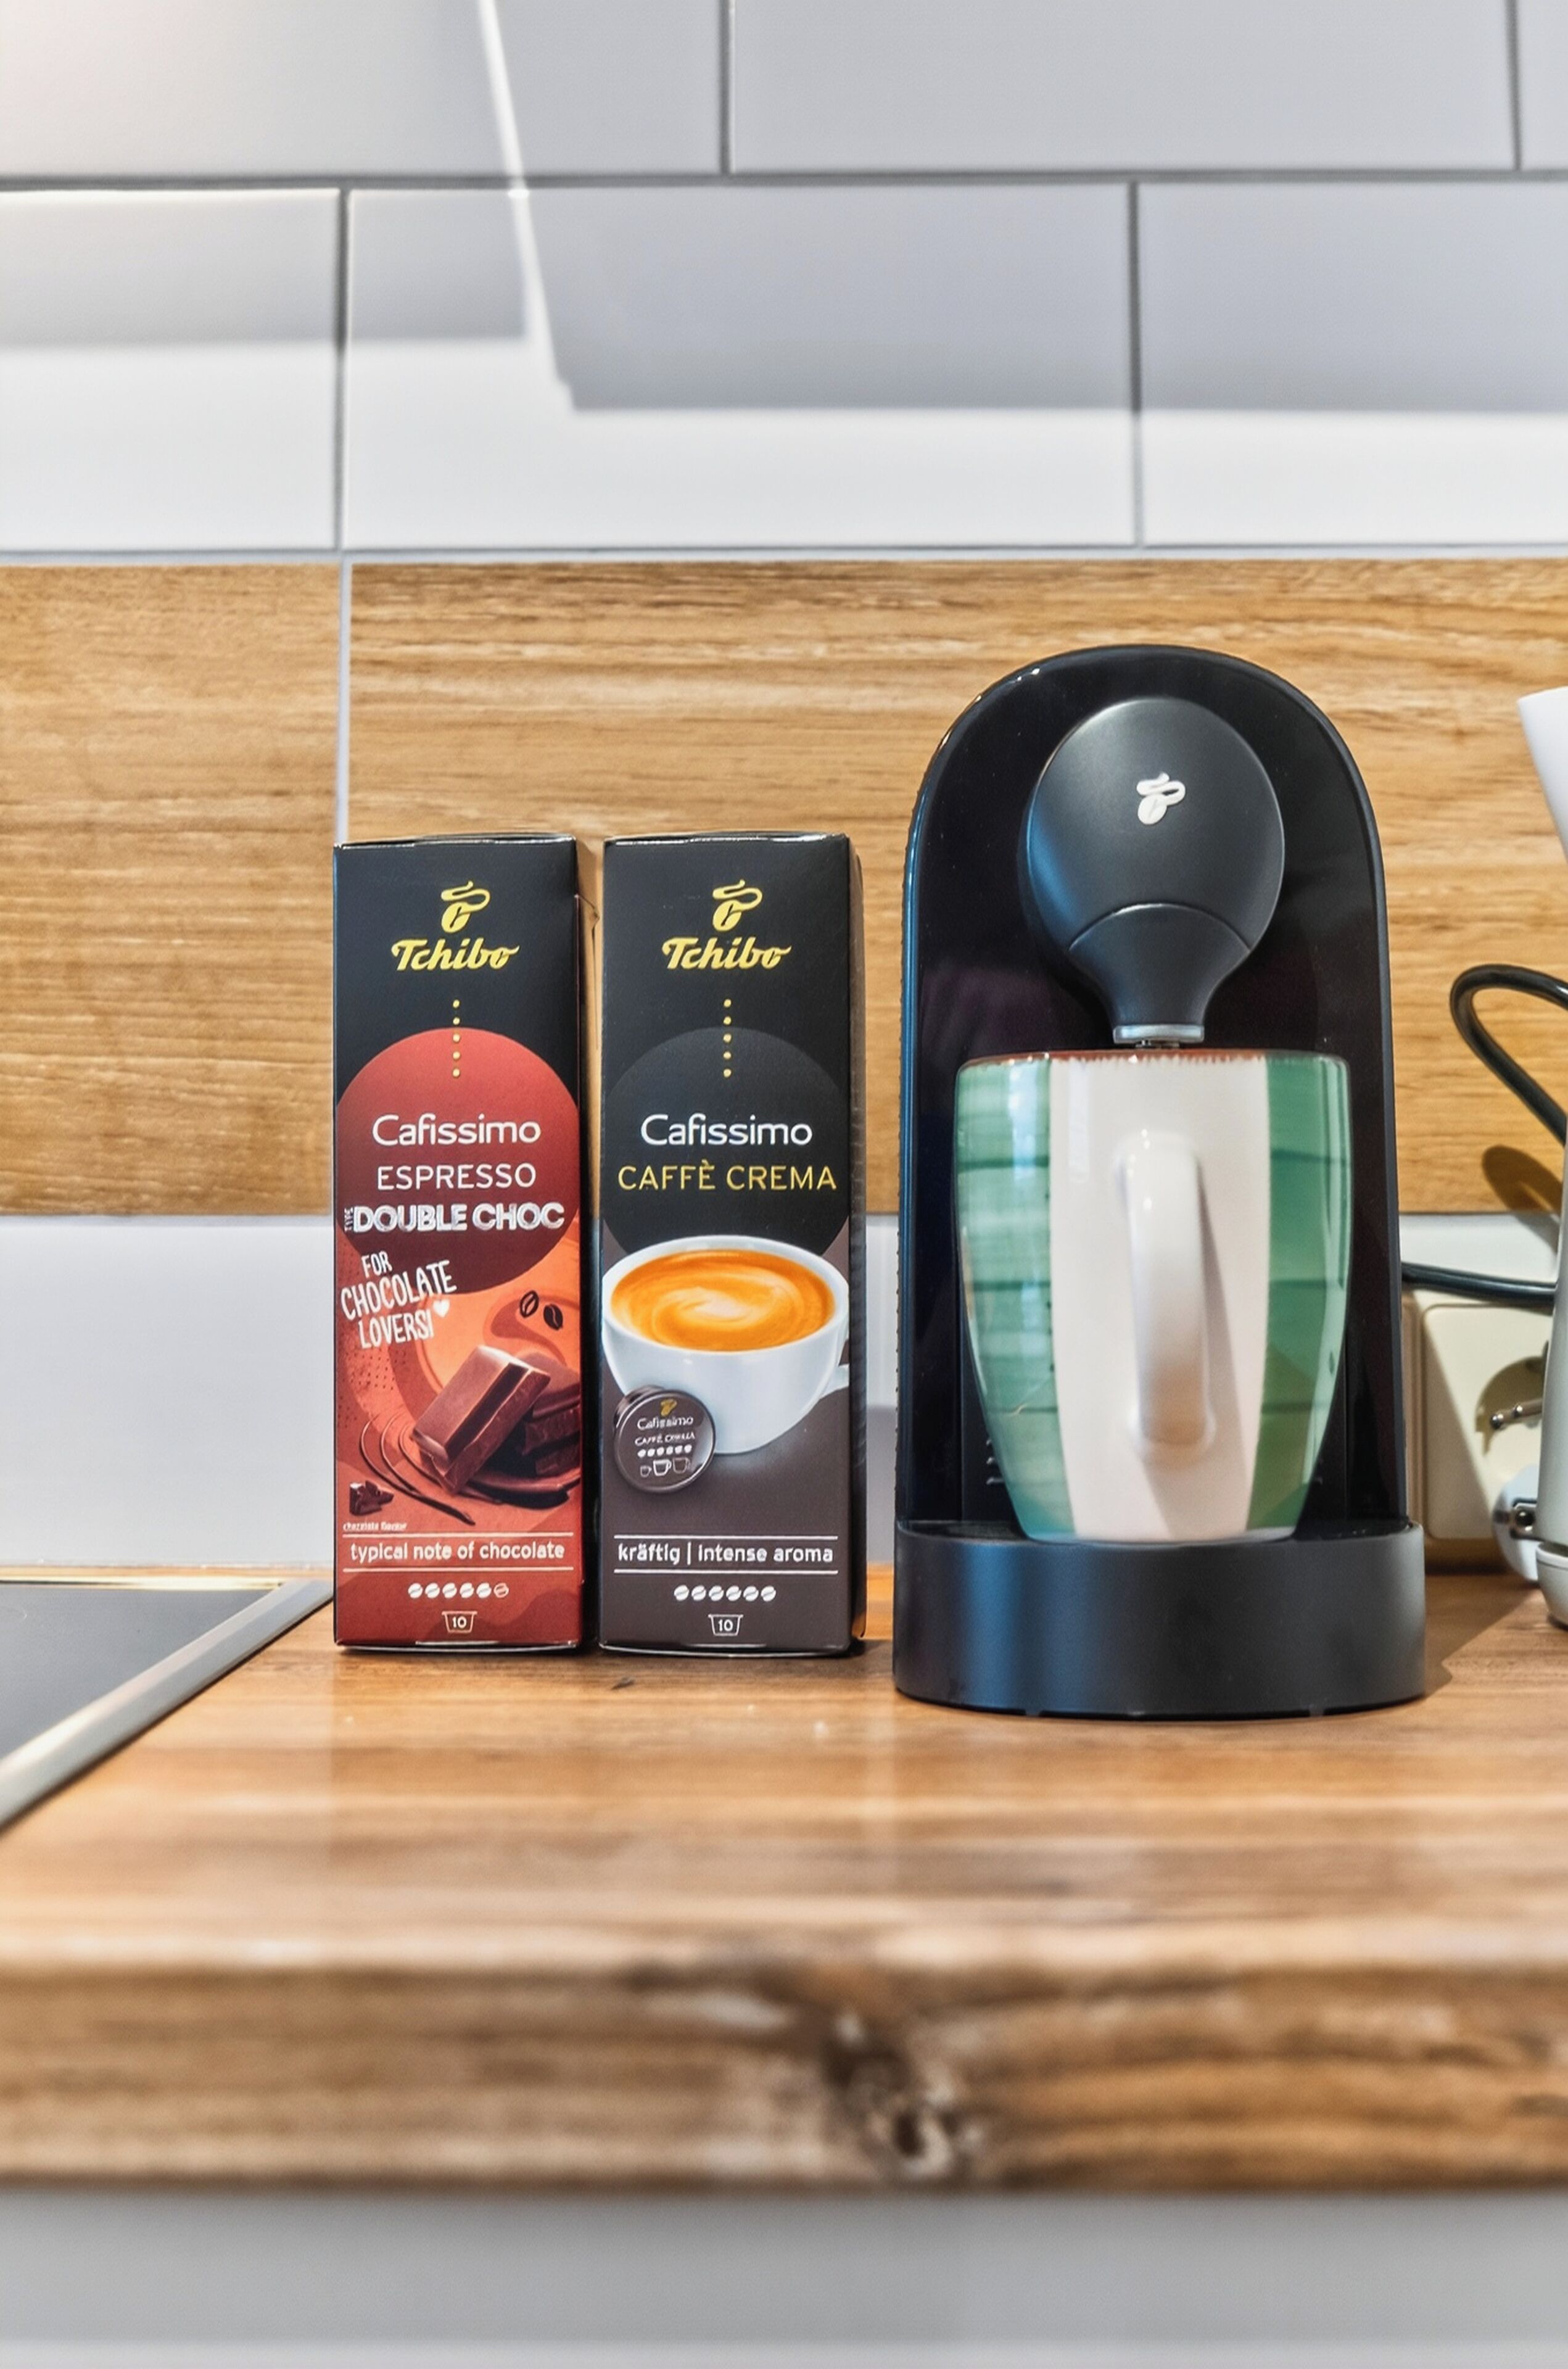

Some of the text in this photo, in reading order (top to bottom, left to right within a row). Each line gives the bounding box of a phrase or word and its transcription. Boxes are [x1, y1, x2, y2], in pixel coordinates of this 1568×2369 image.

[390, 938, 520, 970] Tchibo
[661, 936, 792, 969] Tchibo
[372, 1112, 542, 1146] Cafissimo
[640, 1112, 813, 1146] Cafissimo
[378, 1162, 537, 1191] ESPRESSO
[617, 1159, 837, 1191] CAFFÈ CREMA
[353, 1201, 565, 1233] DOUBLE CHOC
[361, 1250, 393, 1279] FOR
[340, 1259, 458, 1321] CHOCOLATE
[350, 1540, 565, 1564] typical note of chocolate
[617, 1543, 680, 1566] kräftig
[698, 1544, 768, 1562] intense
[773, 1547, 833, 1562] aroma
[451, 1616, 467, 1629] 10
[717, 1619, 734, 1632] 10
